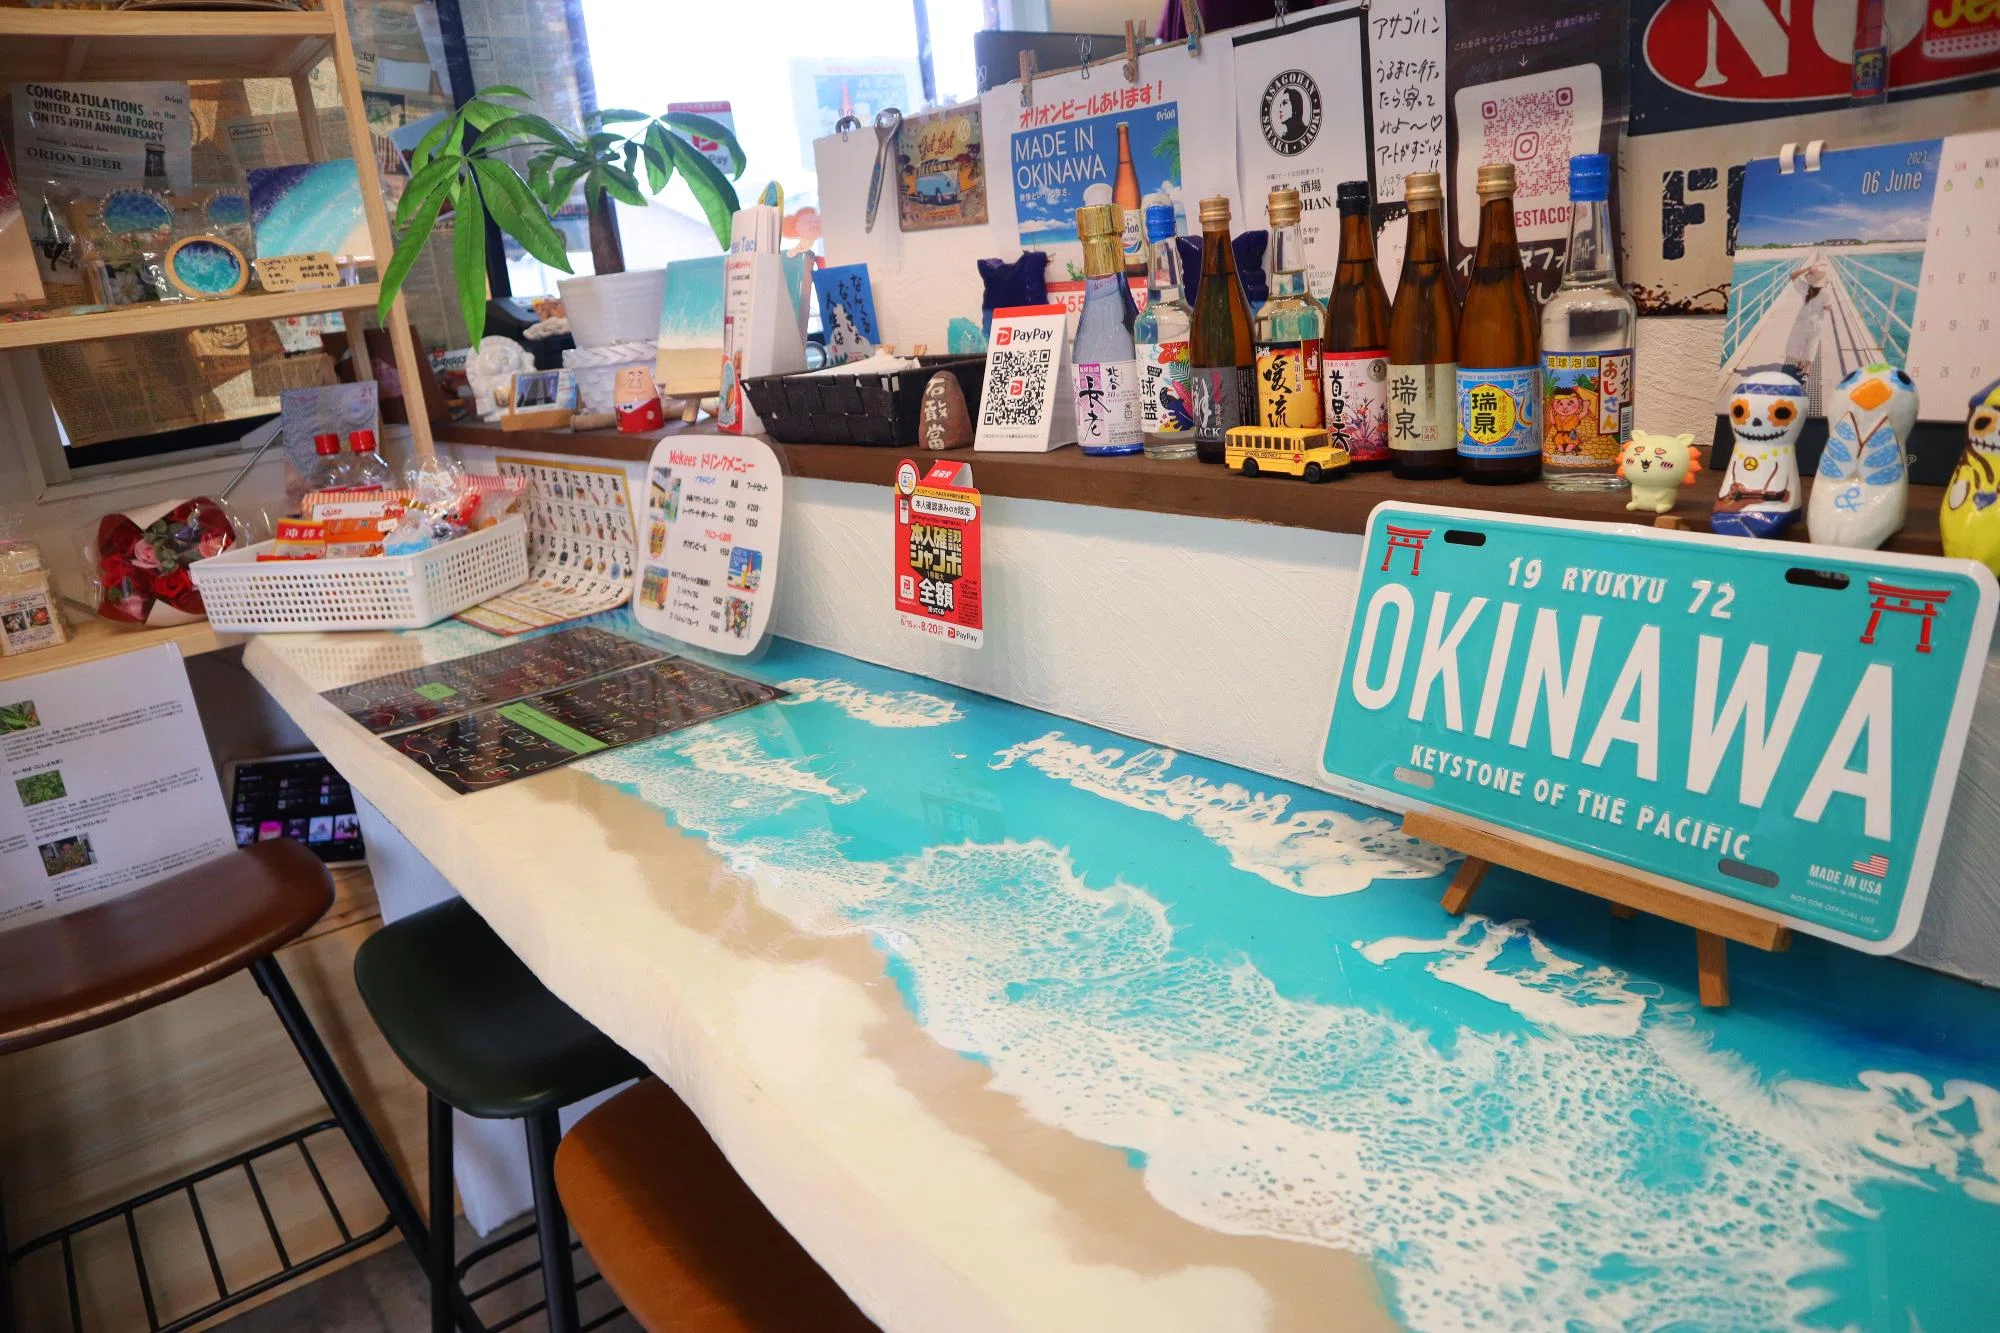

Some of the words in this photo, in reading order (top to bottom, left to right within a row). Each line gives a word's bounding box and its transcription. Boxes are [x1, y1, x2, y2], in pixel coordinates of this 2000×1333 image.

[1373, 8, 1440, 39] アサゴハン
[26, 84, 144, 116] CONGRATULATIONS
[34, 100, 71, 115] UNITED
[75, 106, 111, 122] STATES
[115, 113, 132, 126] AIR
[136, 118, 165, 132] FORCE
[34, 112, 49, 124] ON
[51, 114, 66, 127] ITS
[69, 117, 93, 130] 19TH
[94, 122, 164, 142] ANNIVERSARY
[26, 147, 76, 163] ORION
[82, 156, 123, 170] BEER
[1015, 130, 1067, 163] MADE
[1074, 125, 1095, 152] IN
[1017, 153, 1107, 189] OKINAWA
[1862, 171, 1880, 195] 06
[1885, 170, 1922, 192] June
[1013, 328, 1053, 342] PayPay
[1105, 366, 1120, 390] 北谷
[1621, 358, 1630, 399] ハイサイ
[1392, 375, 1421, 440] 瑞泉
[1603, 360, 1617, 431] おじさん
[1472, 392, 1497, 434] 瑞泉
[701, 453, 754, 473] ドリンクメニュー
[910, 522, 962, 551] 本人確認
[910, 543, 962, 577] ジャンボ
[918, 577, 954, 610] 全額
[1508, 556, 1543, 590] 19
[1561, 566, 1666, 605] RYUKYU
[1687, 580, 1736, 620] 72
[957, 630, 978, 643] PayPay
[1352, 582, 1894, 842] OKINAWA
[1410, 743, 1523, 797] KEYSTONE
[1533, 778, 1566, 807] OF
[1577, 788, 1625, 826] THE
[1636, 805, 1751, 860] PACIFIC
[1809, 864, 1841, 884] MADE
[1844, 874, 1857, 889] IN
[1860, 878, 1883, 896] USA
[1790, 894, 1806, 903] NOT
[1807, 899, 1823, 908] FOR
[1824, 903, 1858, 920] OFFICIAL
[1860, 916, 1876, 924] USE
